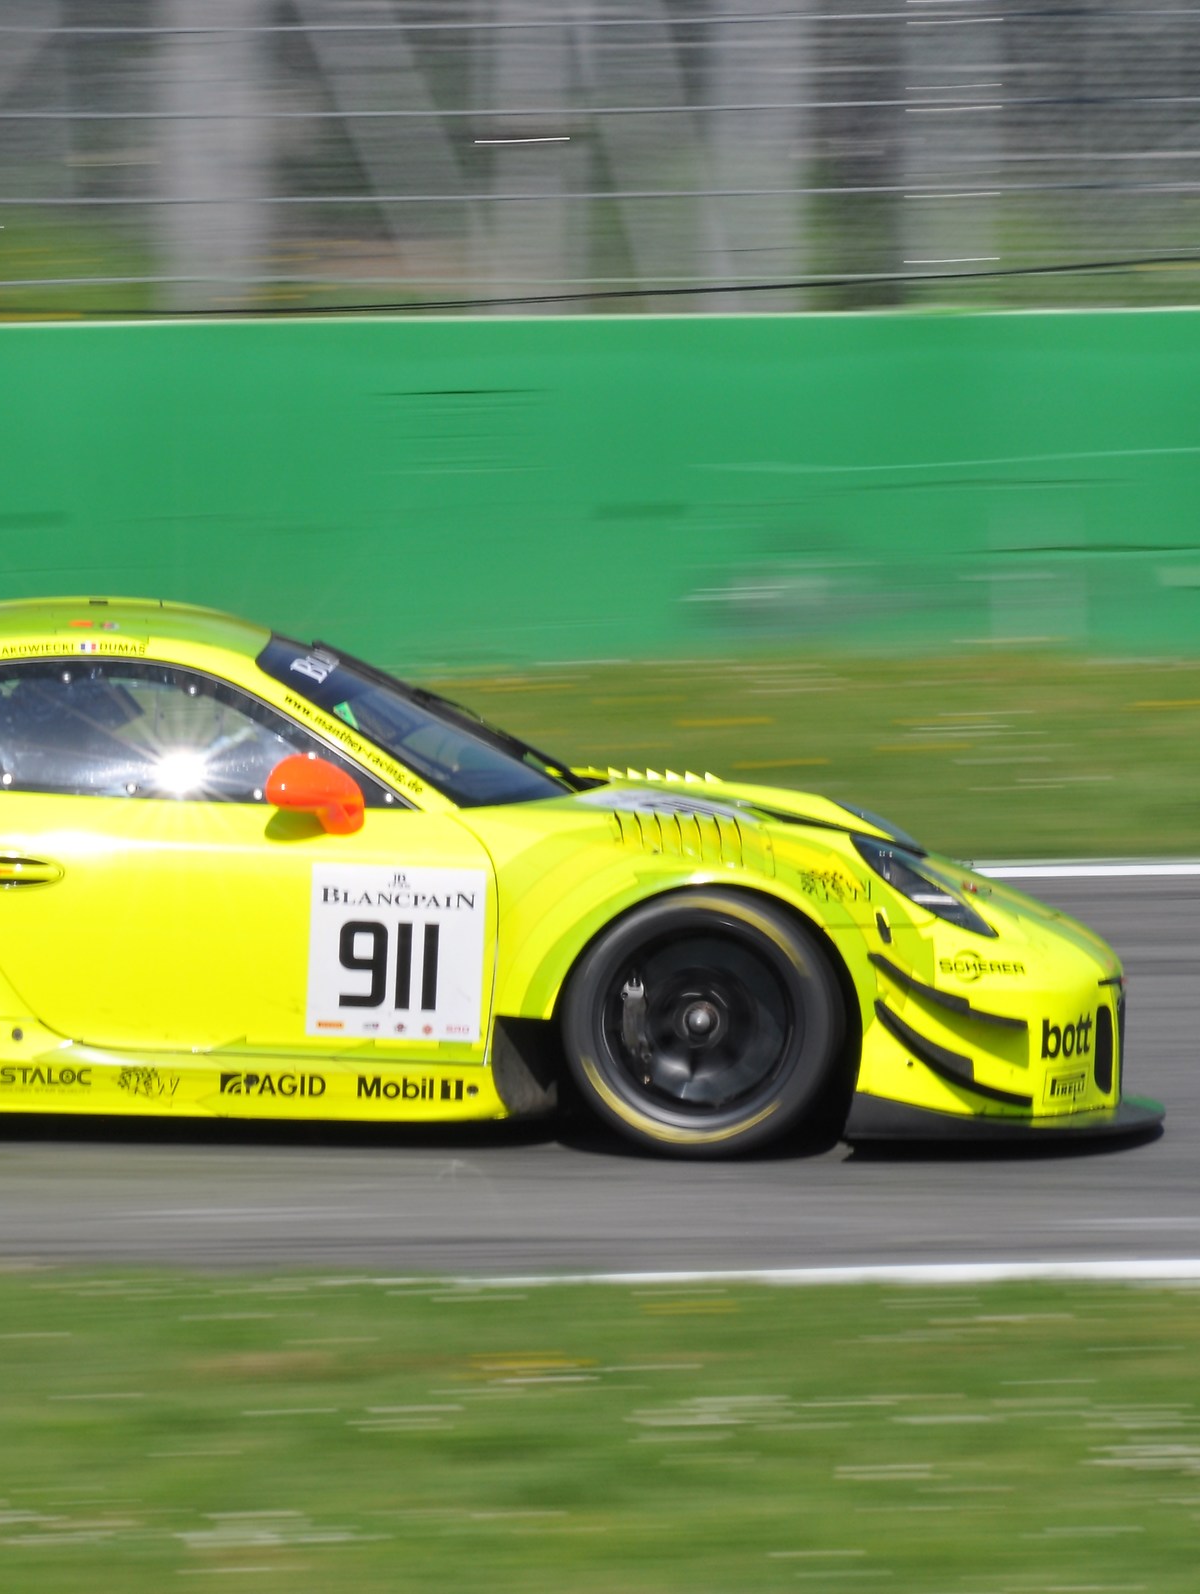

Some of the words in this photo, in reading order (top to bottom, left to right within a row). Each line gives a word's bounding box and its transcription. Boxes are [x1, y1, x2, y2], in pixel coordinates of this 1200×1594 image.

[322, 886, 475, 909] BLANCPAIN
[338, 920, 440, 1011] 911
[1041, 1012, 1092, 1059] bott
[0, 1067, 92, 1086] STALOC
[245, 1074, 327, 1097] PAGID
[357, 1076, 434, 1100] Mobil
[1050, 1073, 1086, 1096] PIRELLI
